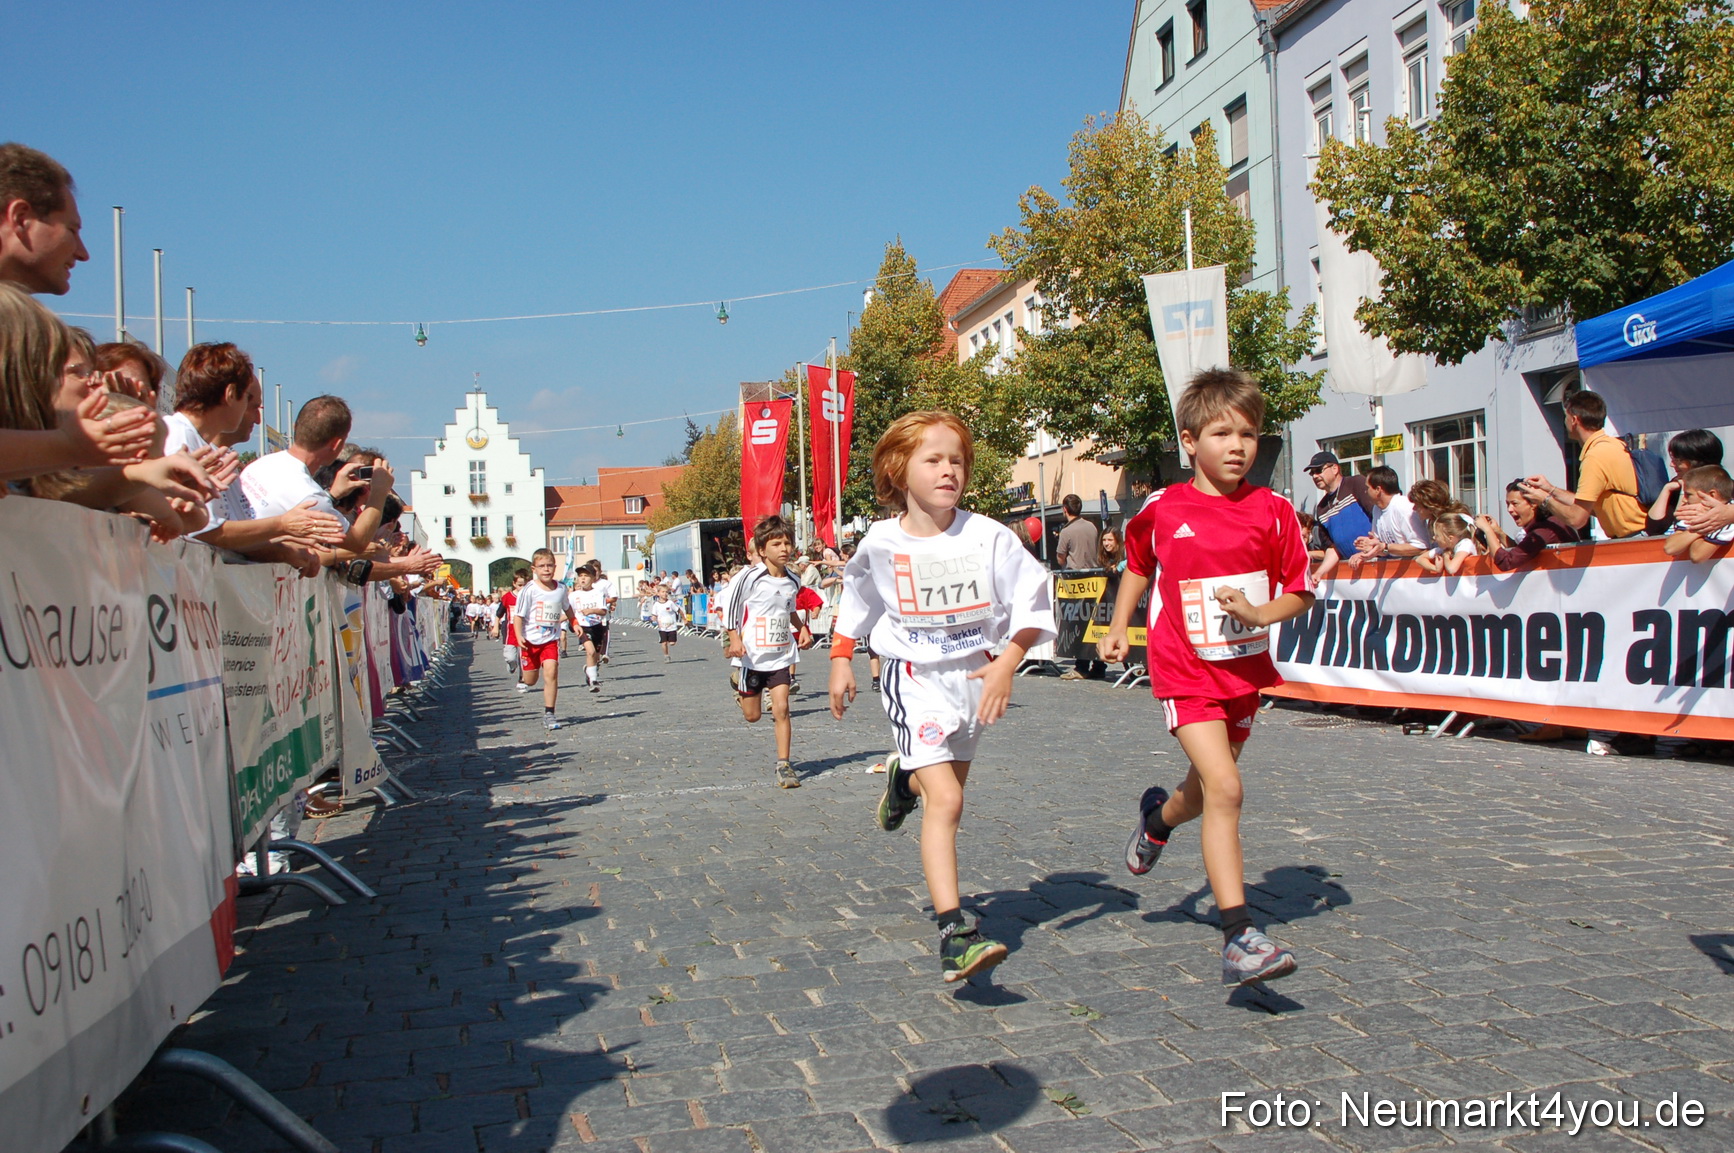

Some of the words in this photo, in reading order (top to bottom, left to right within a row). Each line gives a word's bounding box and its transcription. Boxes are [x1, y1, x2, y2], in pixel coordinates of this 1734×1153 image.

[917, 554, 981, 580] LOUIS
[920, 580, 979, 607] 7171
[0, 571, 127, 672] uhause.
[1187, 612, 1200, 624] K2
[941, 635, 985, 654] Stadtlauf
[1276, 599, 1605, 683] Willkommen
[23, 908, 107, 1016] 09181
